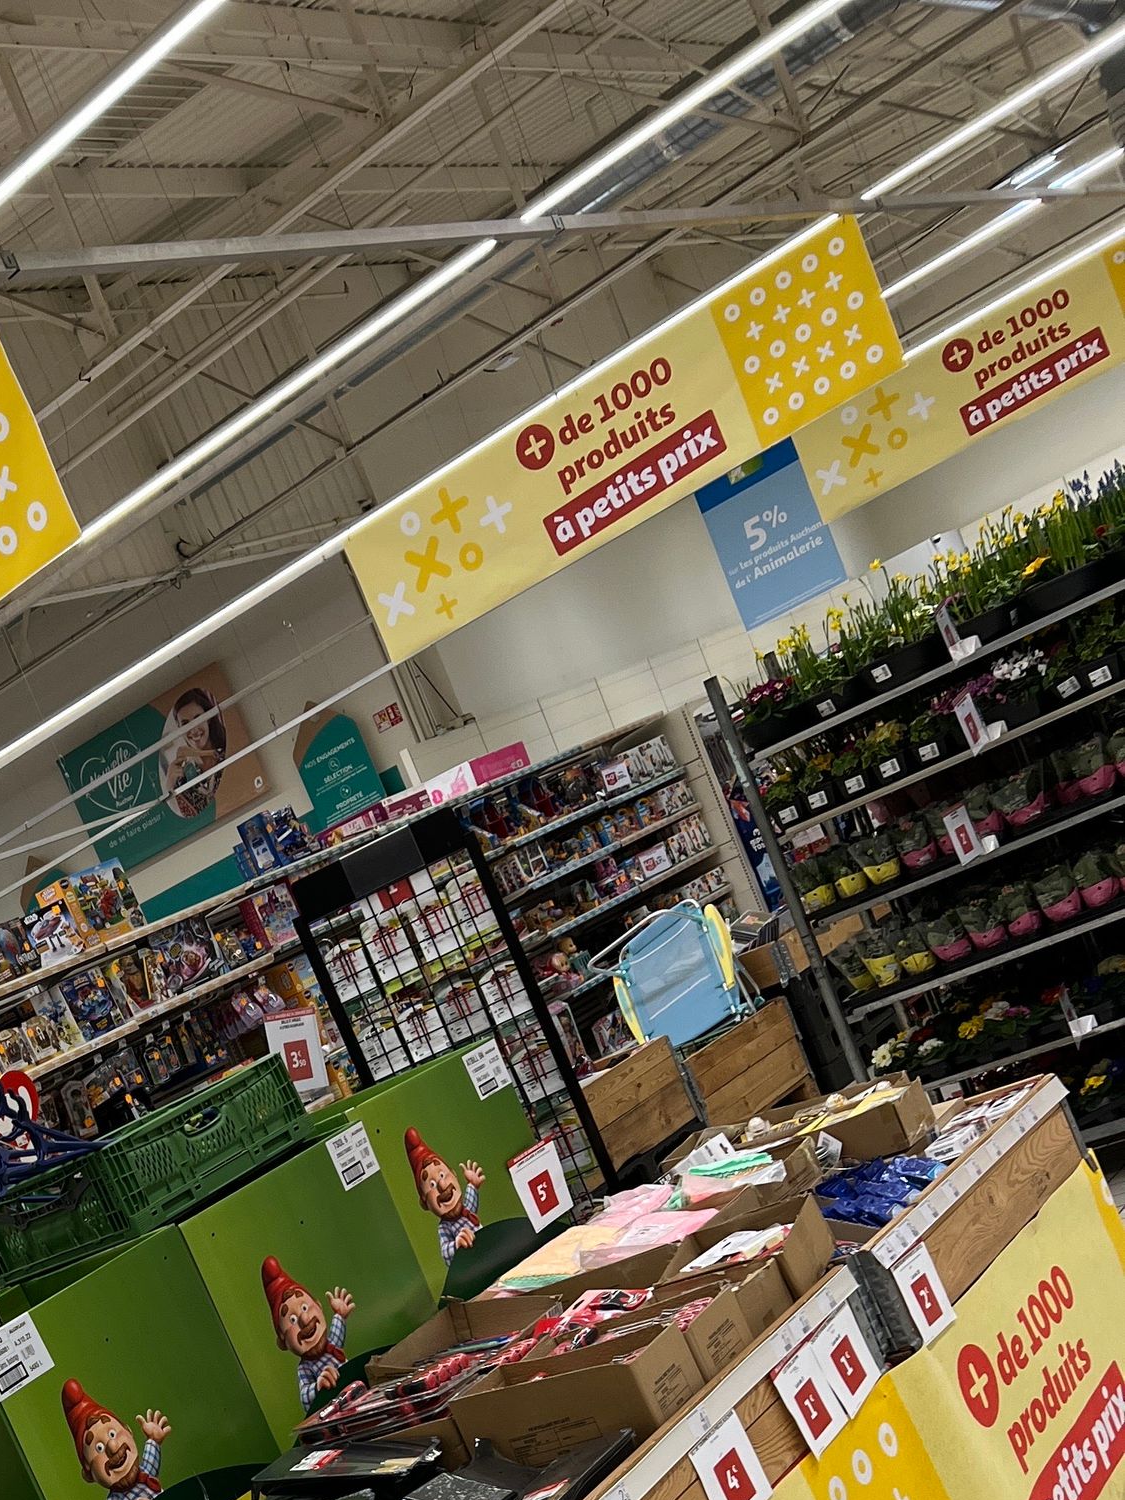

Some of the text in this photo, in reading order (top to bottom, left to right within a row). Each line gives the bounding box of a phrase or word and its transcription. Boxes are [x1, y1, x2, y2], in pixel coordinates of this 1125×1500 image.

[974, 321, 1071, 391] produits
[978, 289, 1069, 353] de 1000
[559, 358, 671, 445] de 1000
[968, 338, 1103, 426] à petits prix
[554, 426, 718, 543] à petits prix
[557, 402, 675, 495] produits
[735, 579, 746, 589] de
[754, 535, 823, 580] Animalerie
[744, 505, 787, 551] 5%
[754, 540, 789, 564] produits
[790, 522, 822, 544] Auchan
[107, 772, 132, 799] Vie
[997, 1265, 1073, 1386] de 1000
[1007, 1338, 1091, 1475] produits
[1091, 1384, 1125, 1469] prix
